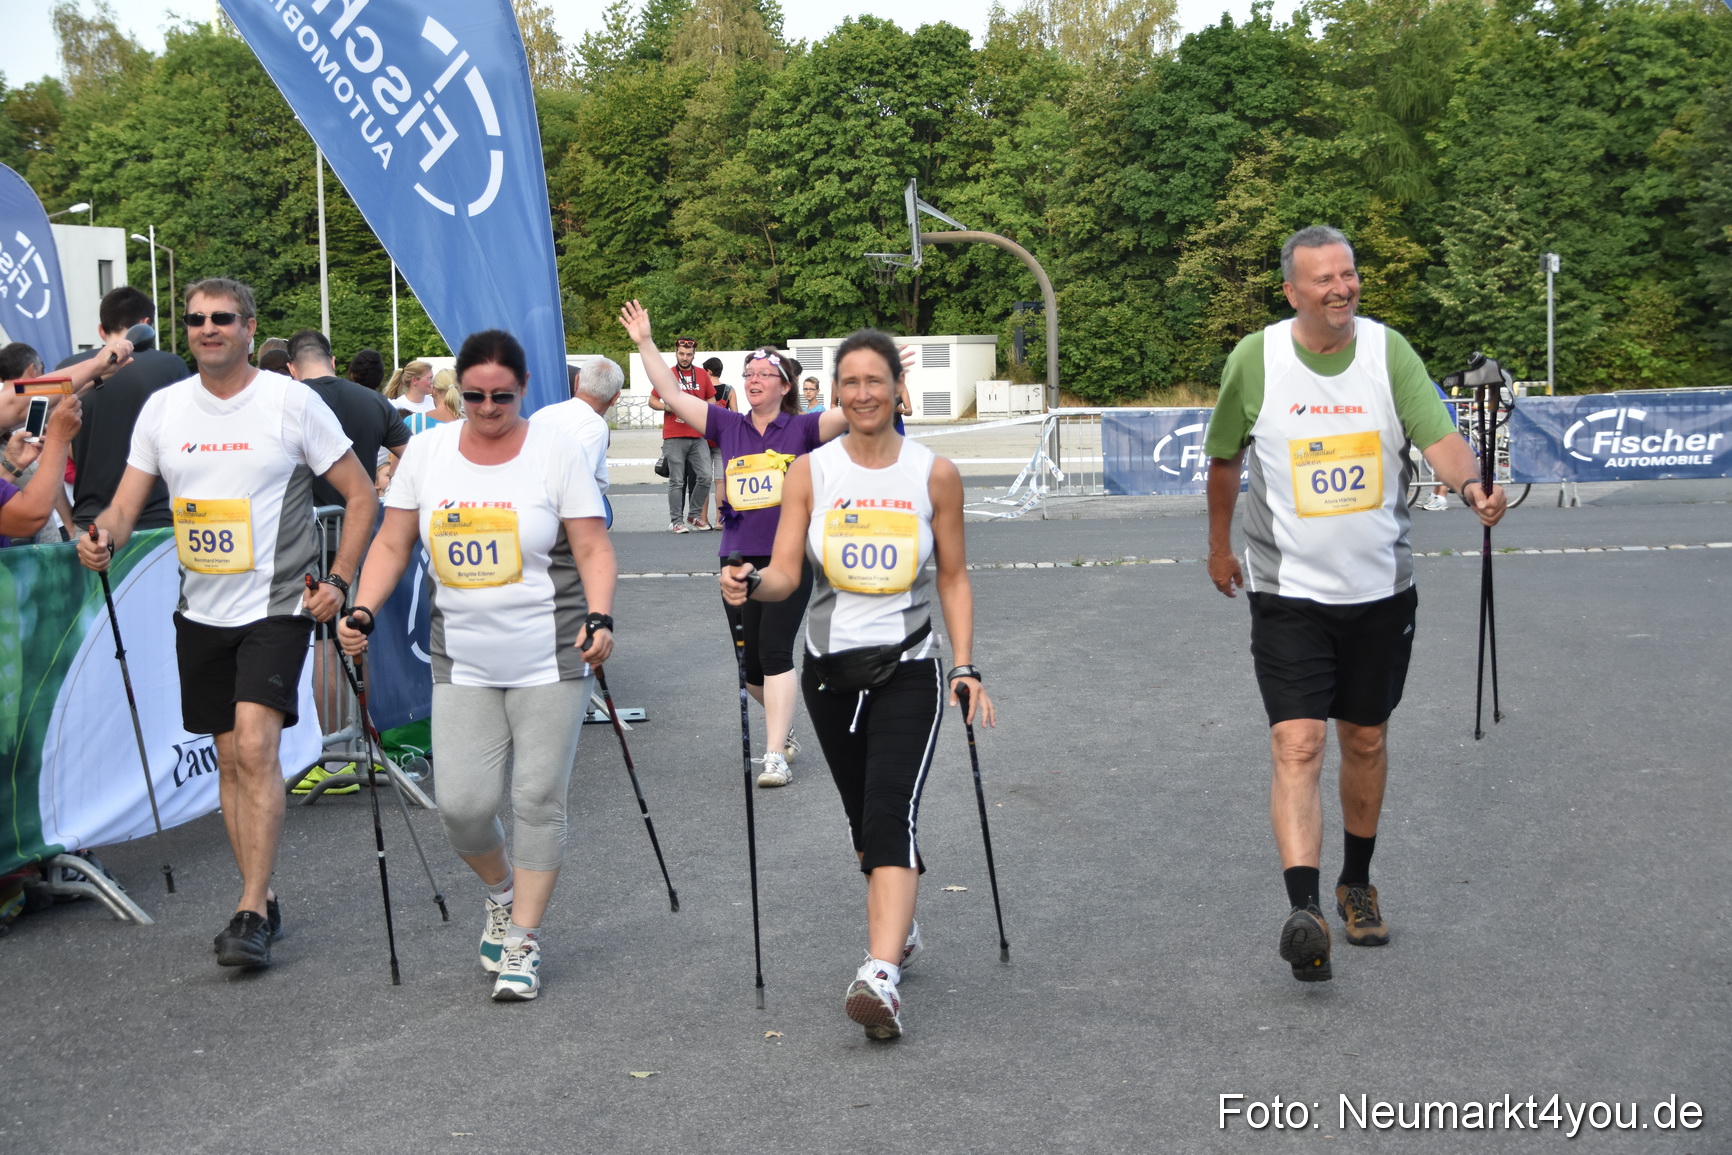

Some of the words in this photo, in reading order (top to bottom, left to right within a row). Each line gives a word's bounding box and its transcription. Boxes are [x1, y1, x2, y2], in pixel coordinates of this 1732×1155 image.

[1310, 405, 1368, 414] KLEBL
[201, 443, 254, 452] KLEBL
[1592, 428, 1724, 455] Fischer
[1604, 454, 1714, 468] AUTOMOBILE
[737, 475, 772, 495] 704
[1311, 465, 1365, 494] 602
[459, 501, 517, 509] KLEBL
[856, 499, 916, 510] KLEBL
[189, 529, 234, 553] 598
[448, 539, 498, 566] 601
[842, 543, 897, 570] 600
